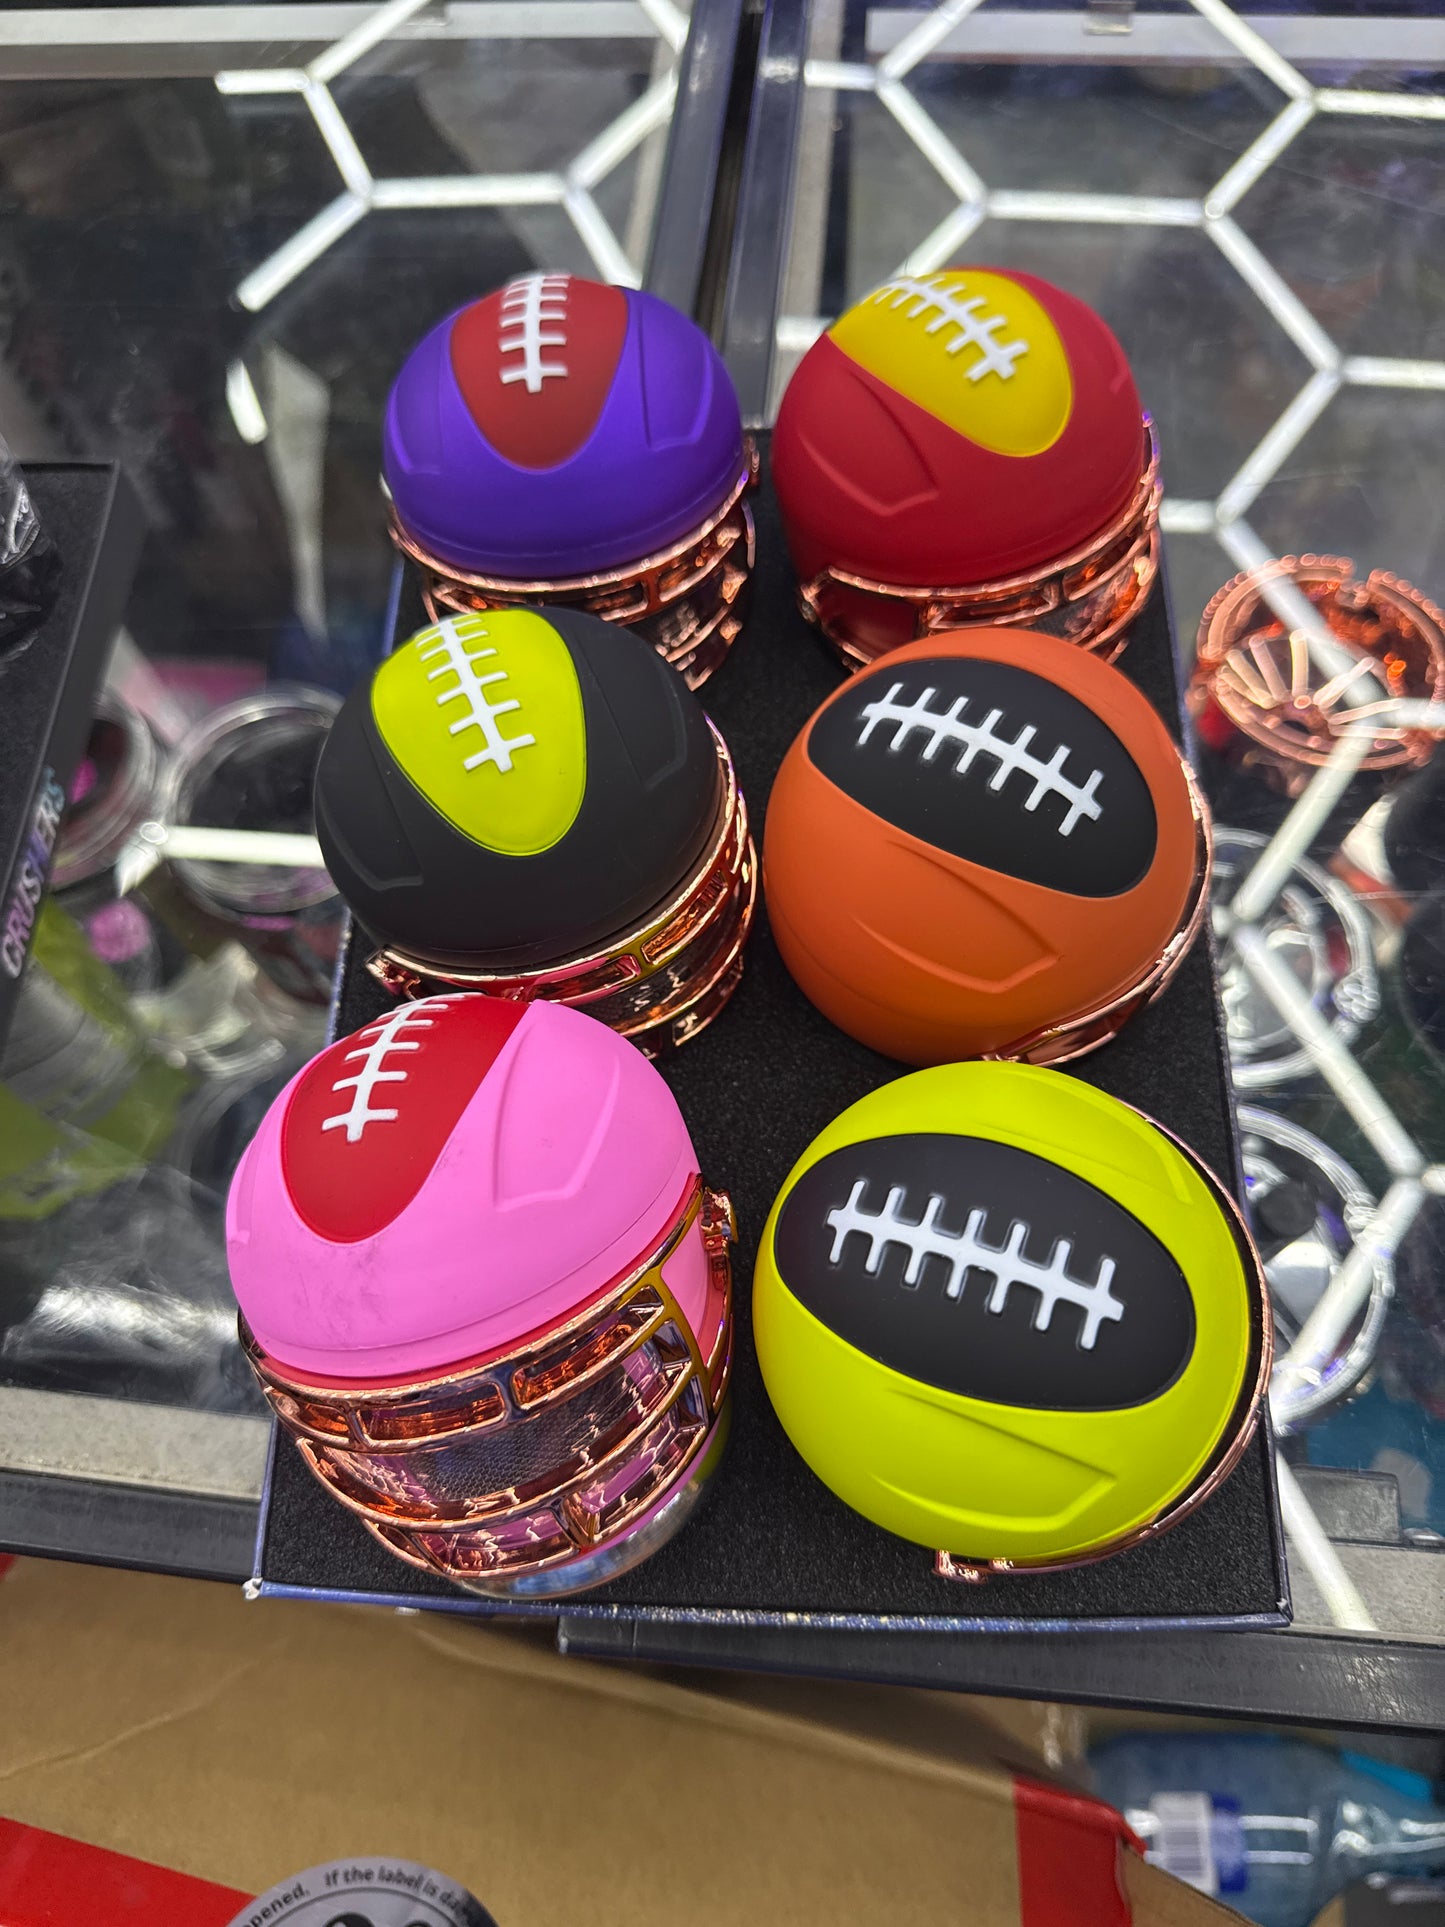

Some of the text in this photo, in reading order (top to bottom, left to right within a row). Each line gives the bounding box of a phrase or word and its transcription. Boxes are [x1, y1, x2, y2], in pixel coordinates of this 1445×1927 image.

[242, 1881, 311, 1927] pened.
[323, 1868, 339, 1887] If
[342, 1866, 375, 1884] the
[378, 1865, 424, 1892] label
